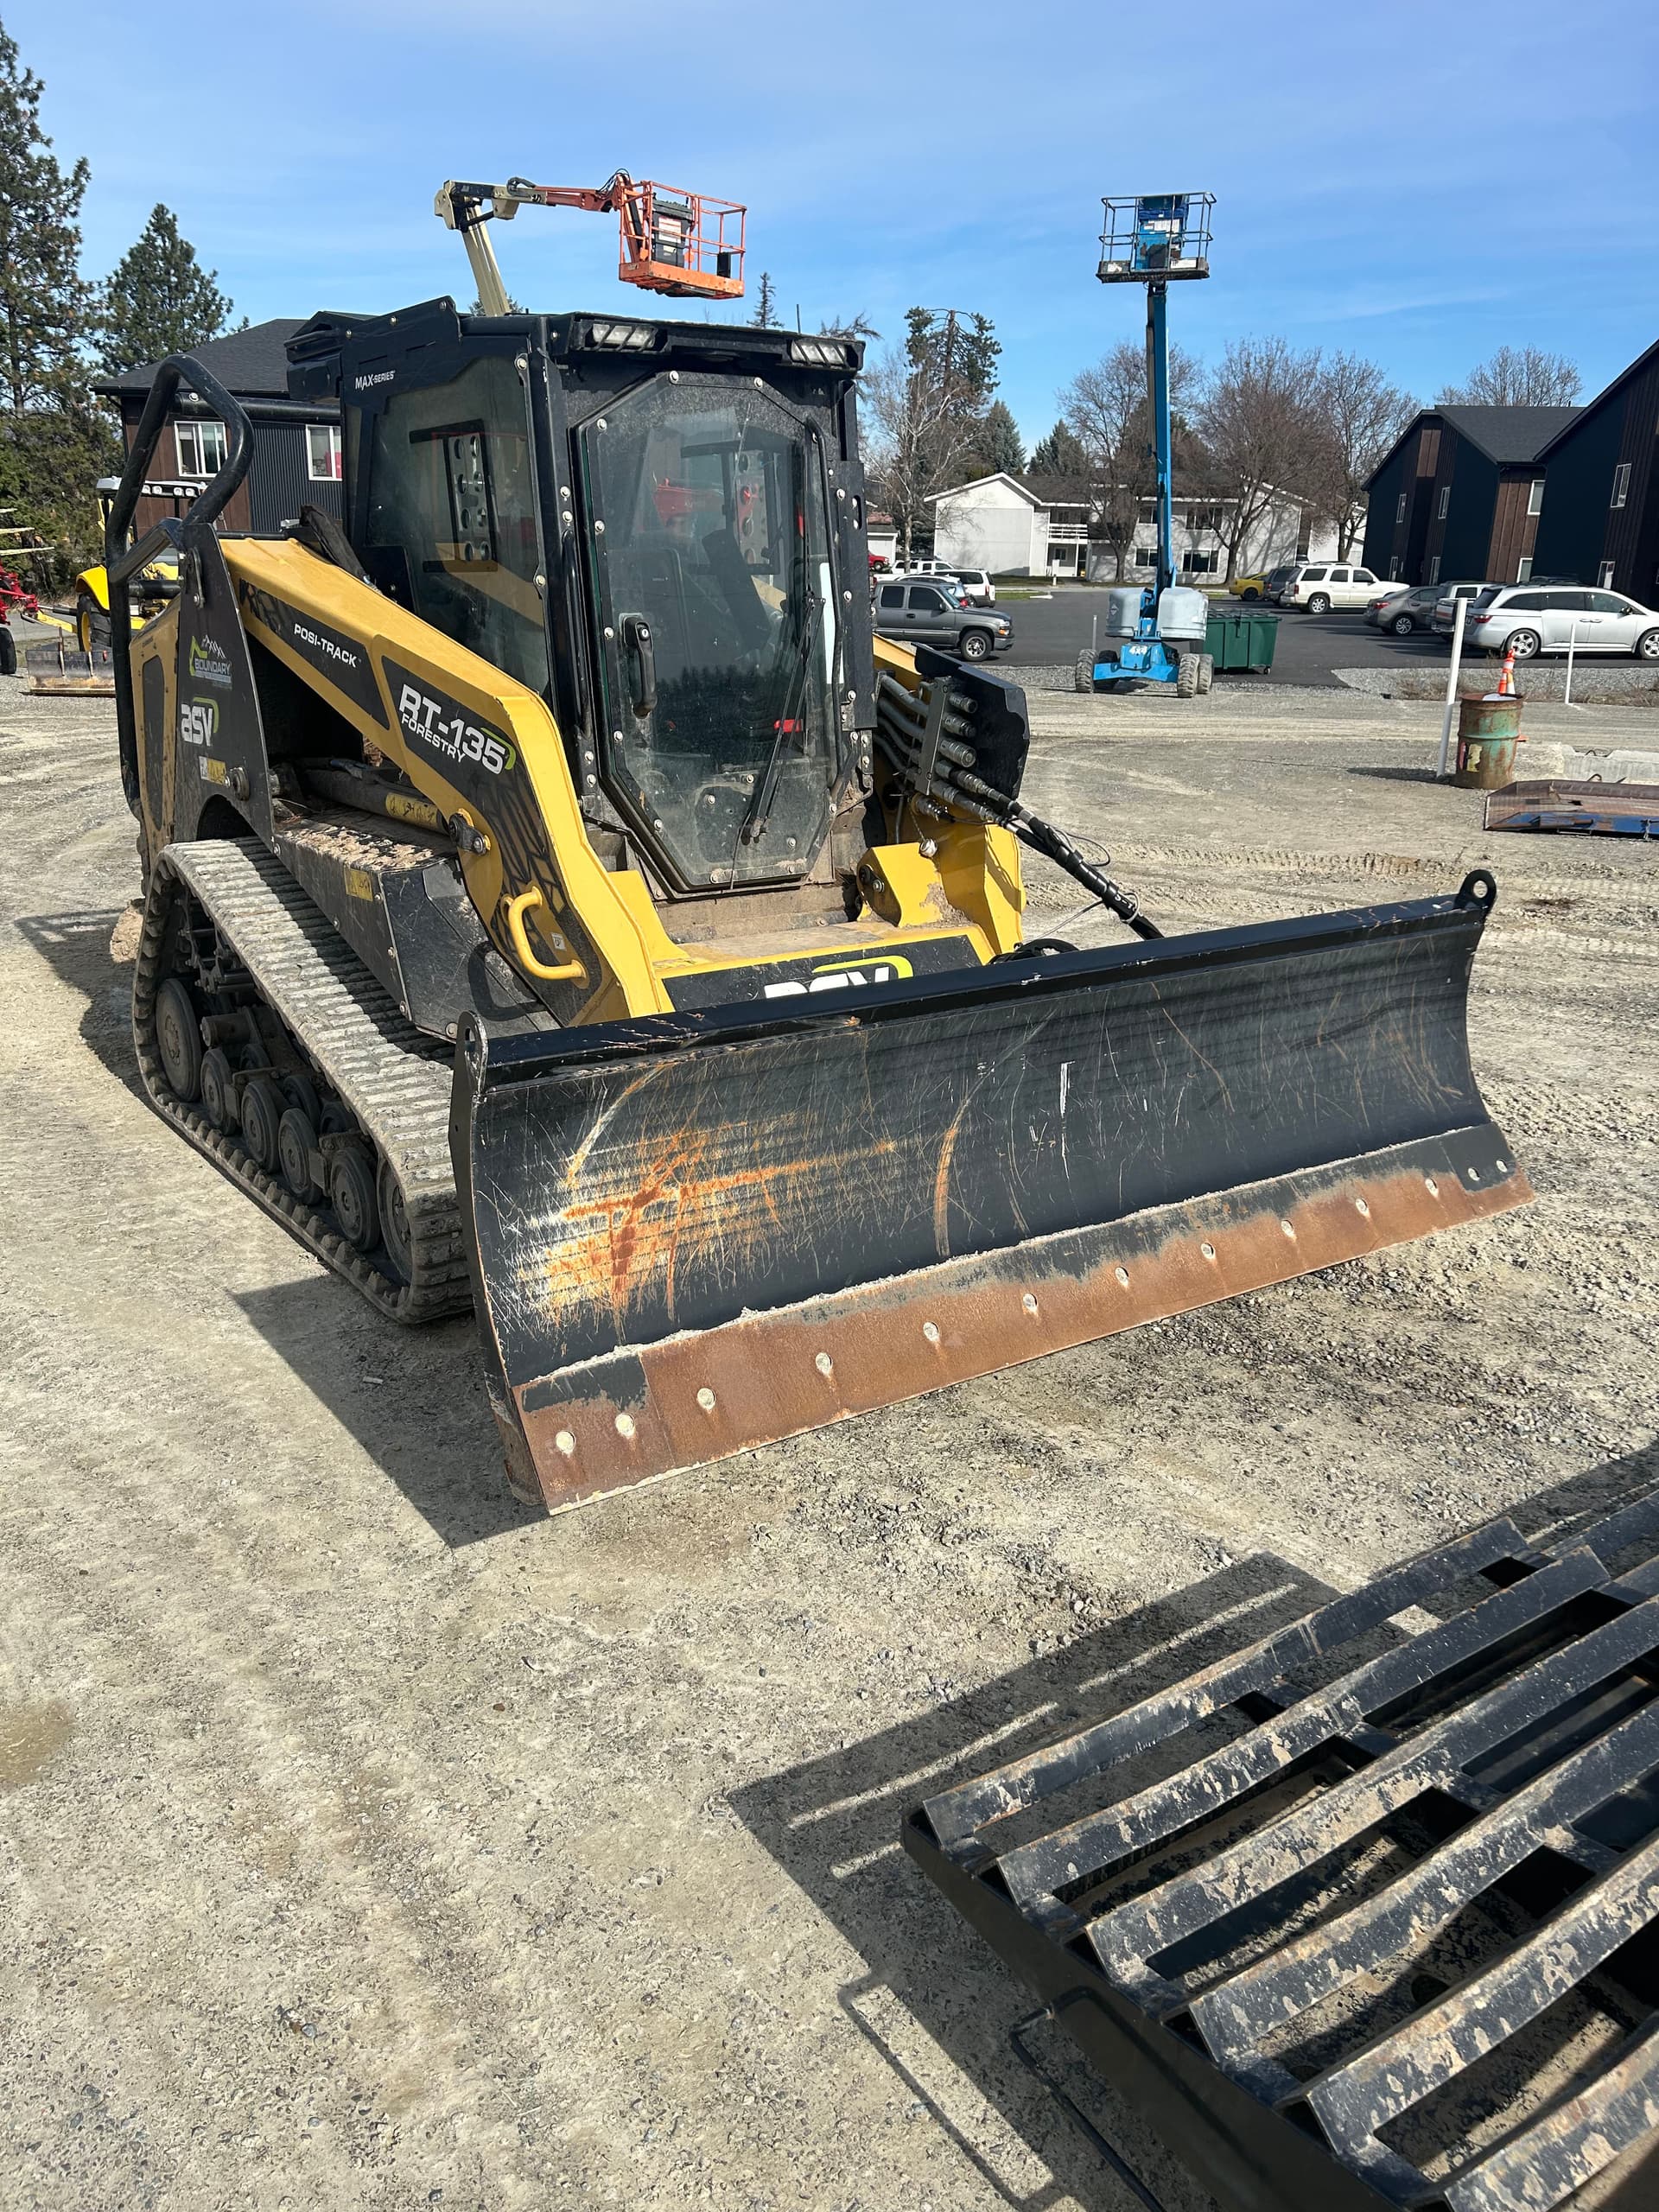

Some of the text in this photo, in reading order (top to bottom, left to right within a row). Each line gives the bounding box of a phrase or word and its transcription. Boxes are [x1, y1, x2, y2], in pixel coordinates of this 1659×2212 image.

[194, 658, 231, 675] BOUNDARY
[294, 623, 357, 668] POSI-TRACK
[398, 683, 504, 774] RT-135
[401, 713, 466, 762] FORESTRY
